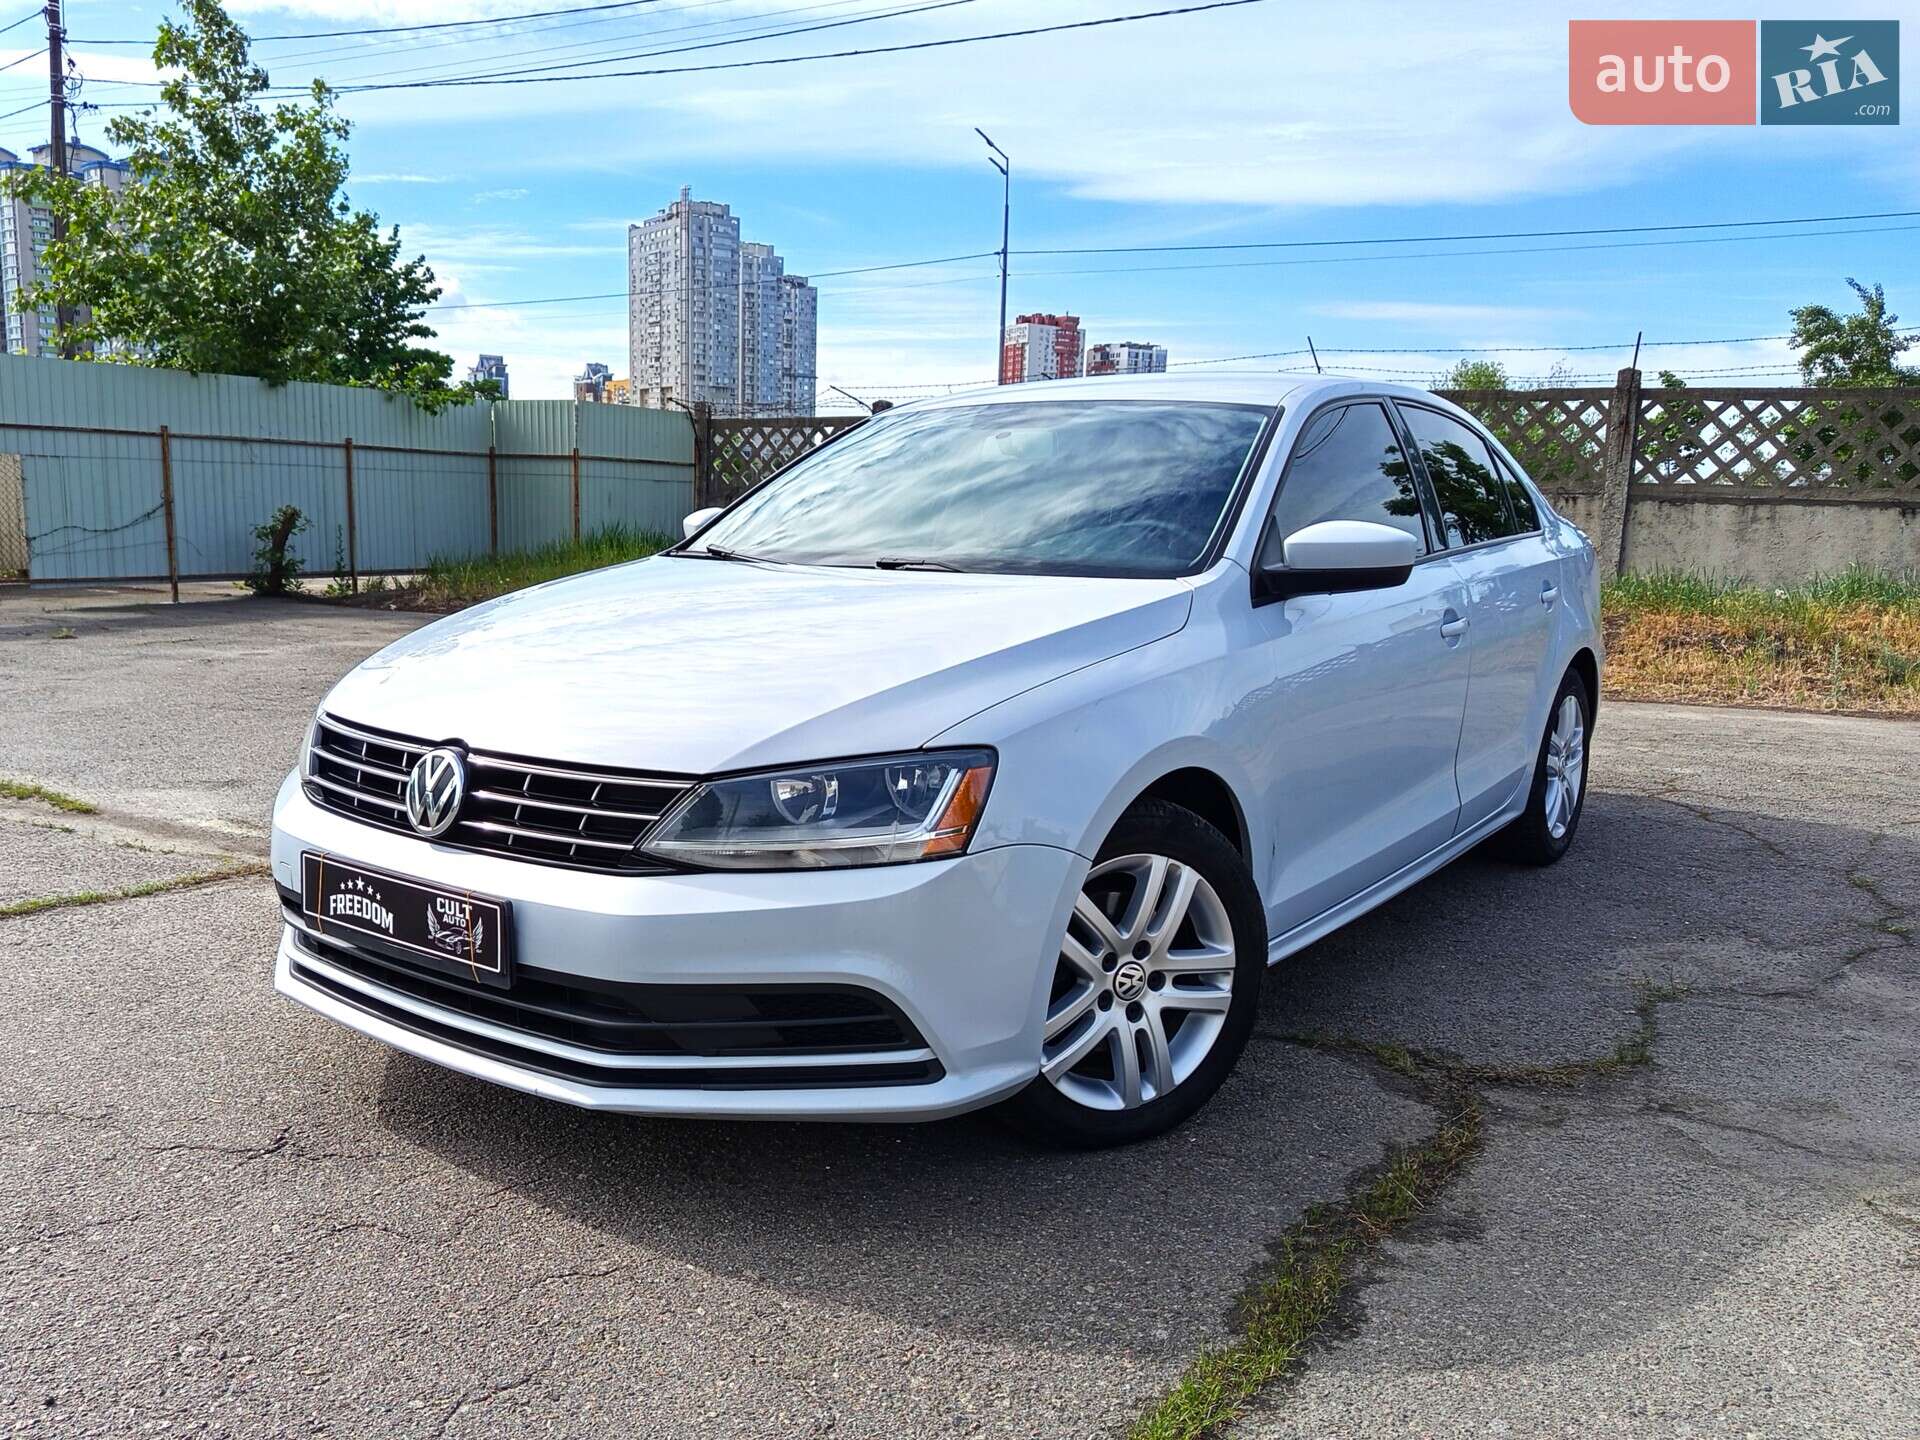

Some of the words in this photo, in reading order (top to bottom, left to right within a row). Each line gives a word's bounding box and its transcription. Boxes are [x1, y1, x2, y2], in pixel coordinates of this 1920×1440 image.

[329, 893, 394, 935] FREEDOM
[436, 897, 473, 920] CULT
[442, 913, 466, 928] AUTO
